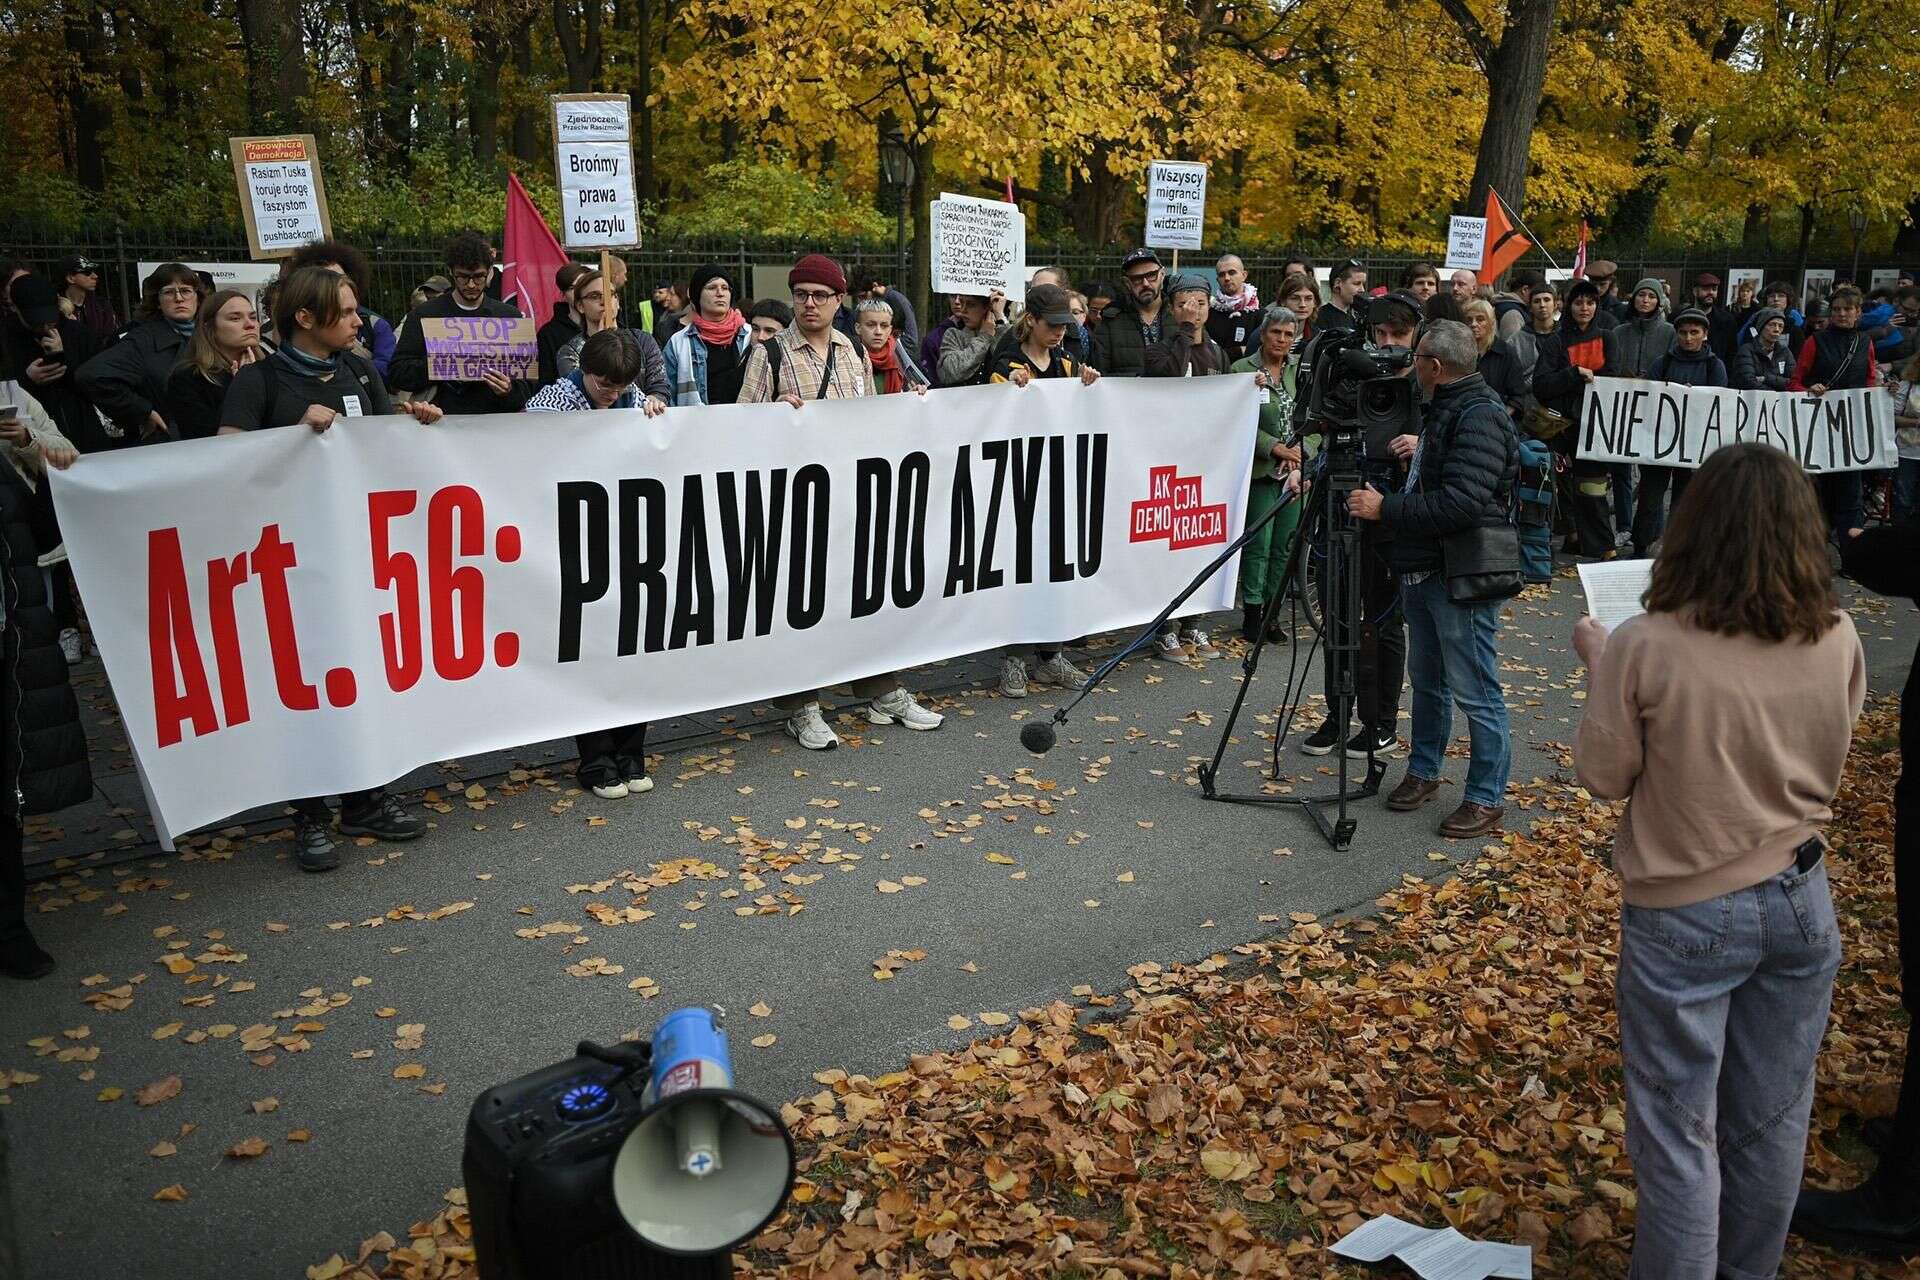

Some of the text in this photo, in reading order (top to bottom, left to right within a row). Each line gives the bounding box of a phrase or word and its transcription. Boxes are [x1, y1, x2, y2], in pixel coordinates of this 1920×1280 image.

[567, 115, 618, 125] Zjednoczeni
[245, 142, 302, 151] Pracownicza
[249, 150, 303, 160] Demokracja
[251, 165, 307, 179] Rasizm Tuska
[570, 153, 618, 177] Brońmy
[1156, 167, 1203, 188] Wszyscy
[255, 182, 308, 198] toruje drogę
[579, 188, 616, 207] prawa
[1156, 186, 1201, 201] migranci
[262, 200, 308, 214] faszystom
[1166, 203, 1188, 215] mile
[277, 218, 300, 229] STOP
[574, 214, 625, 237] do azylu
[1153, 217, 1198, 231] widziani!
[1453, 219, 1485, 231] Wszyscy
[263, 229, 318, 244] pushbackom!
[948, 246, 971, 259] DOMU
[444, 317, 518, 342] STOP
[432, 356, 460, 379] NA
[1584, 390, 1875, 471] NIE DLA RASIZMU
[1154, 473, 1199, 510] AK CJA
[1136, 505, 1222, 542] DEMO KRACJA
[149, 433, 1108, 748] Art. 56: PRAWO DO AZYLU
